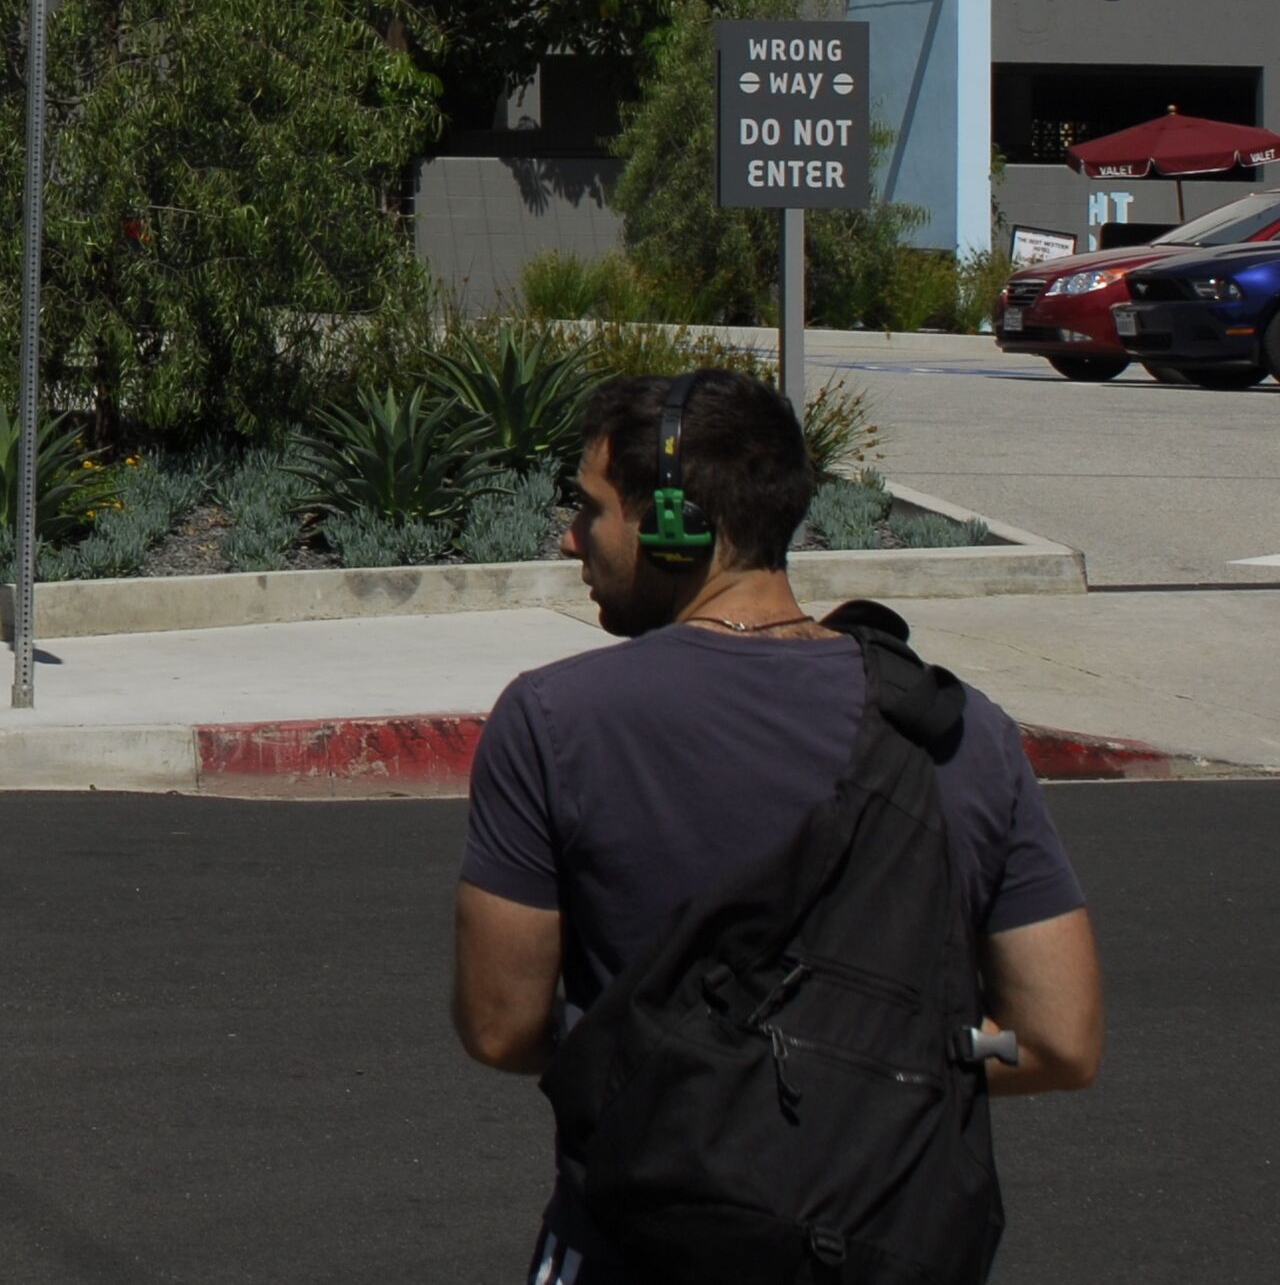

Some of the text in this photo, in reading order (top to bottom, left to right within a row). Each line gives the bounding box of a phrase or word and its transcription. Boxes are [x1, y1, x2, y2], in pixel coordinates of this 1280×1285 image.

[748, 38, 843, 62] WRONG
[769, 72, 824, 100] WAY
[740, 118, 853, 147] DO NOT
[1250, 149, 1276, 163] VALET
[747, 159, 845, 188] ENTER
[1099, 165, 1133, 176] VALET
